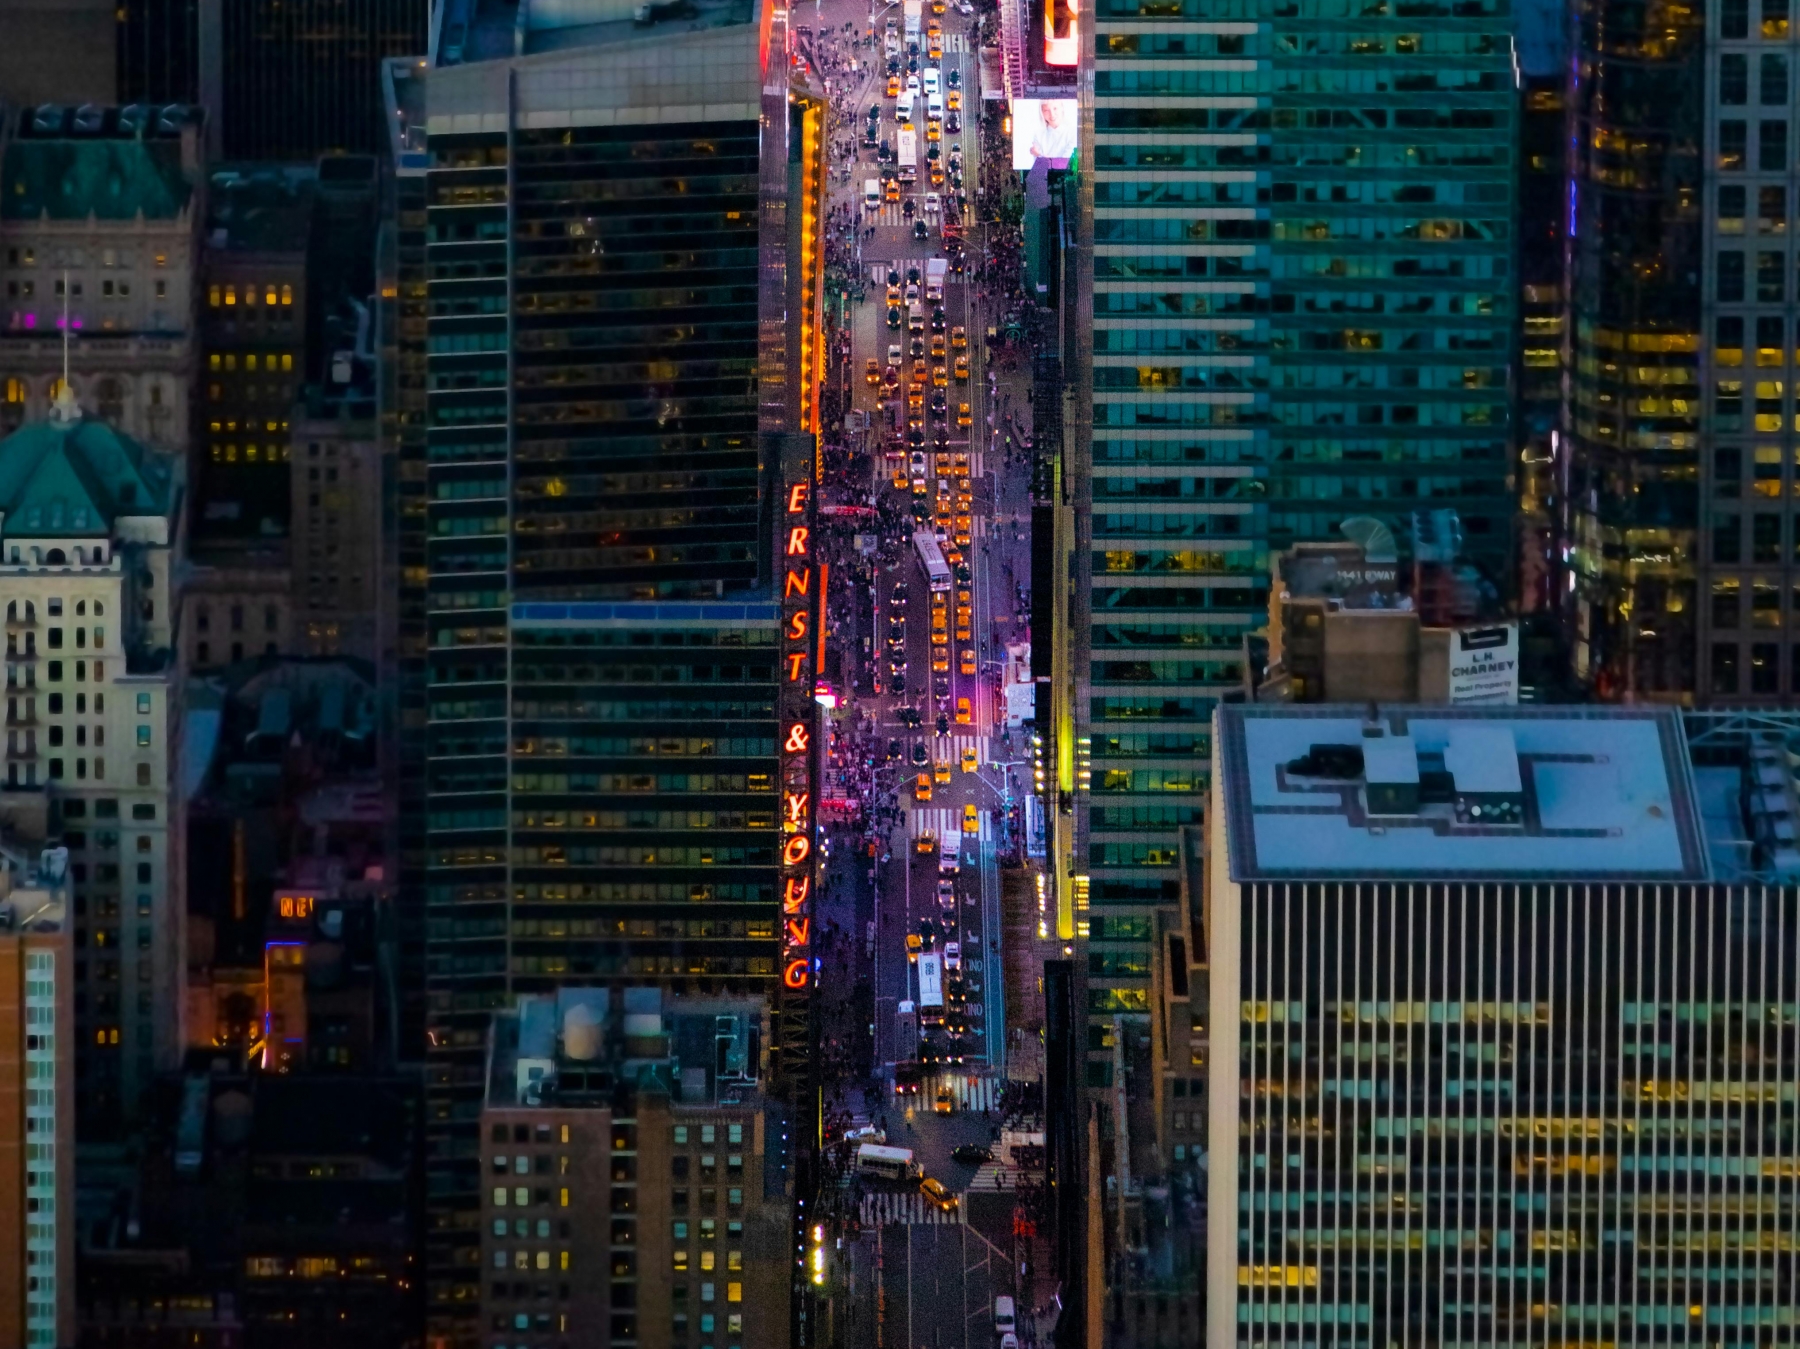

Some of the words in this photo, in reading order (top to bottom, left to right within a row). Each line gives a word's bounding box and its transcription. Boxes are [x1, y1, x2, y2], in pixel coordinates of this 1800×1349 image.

[785, 482, 810, 683] ERNST
[1451, 660, 1515, 677] CHARNEY
[785, 723, 810, 753] &
[783, 792, 810, 989] YOUNG
